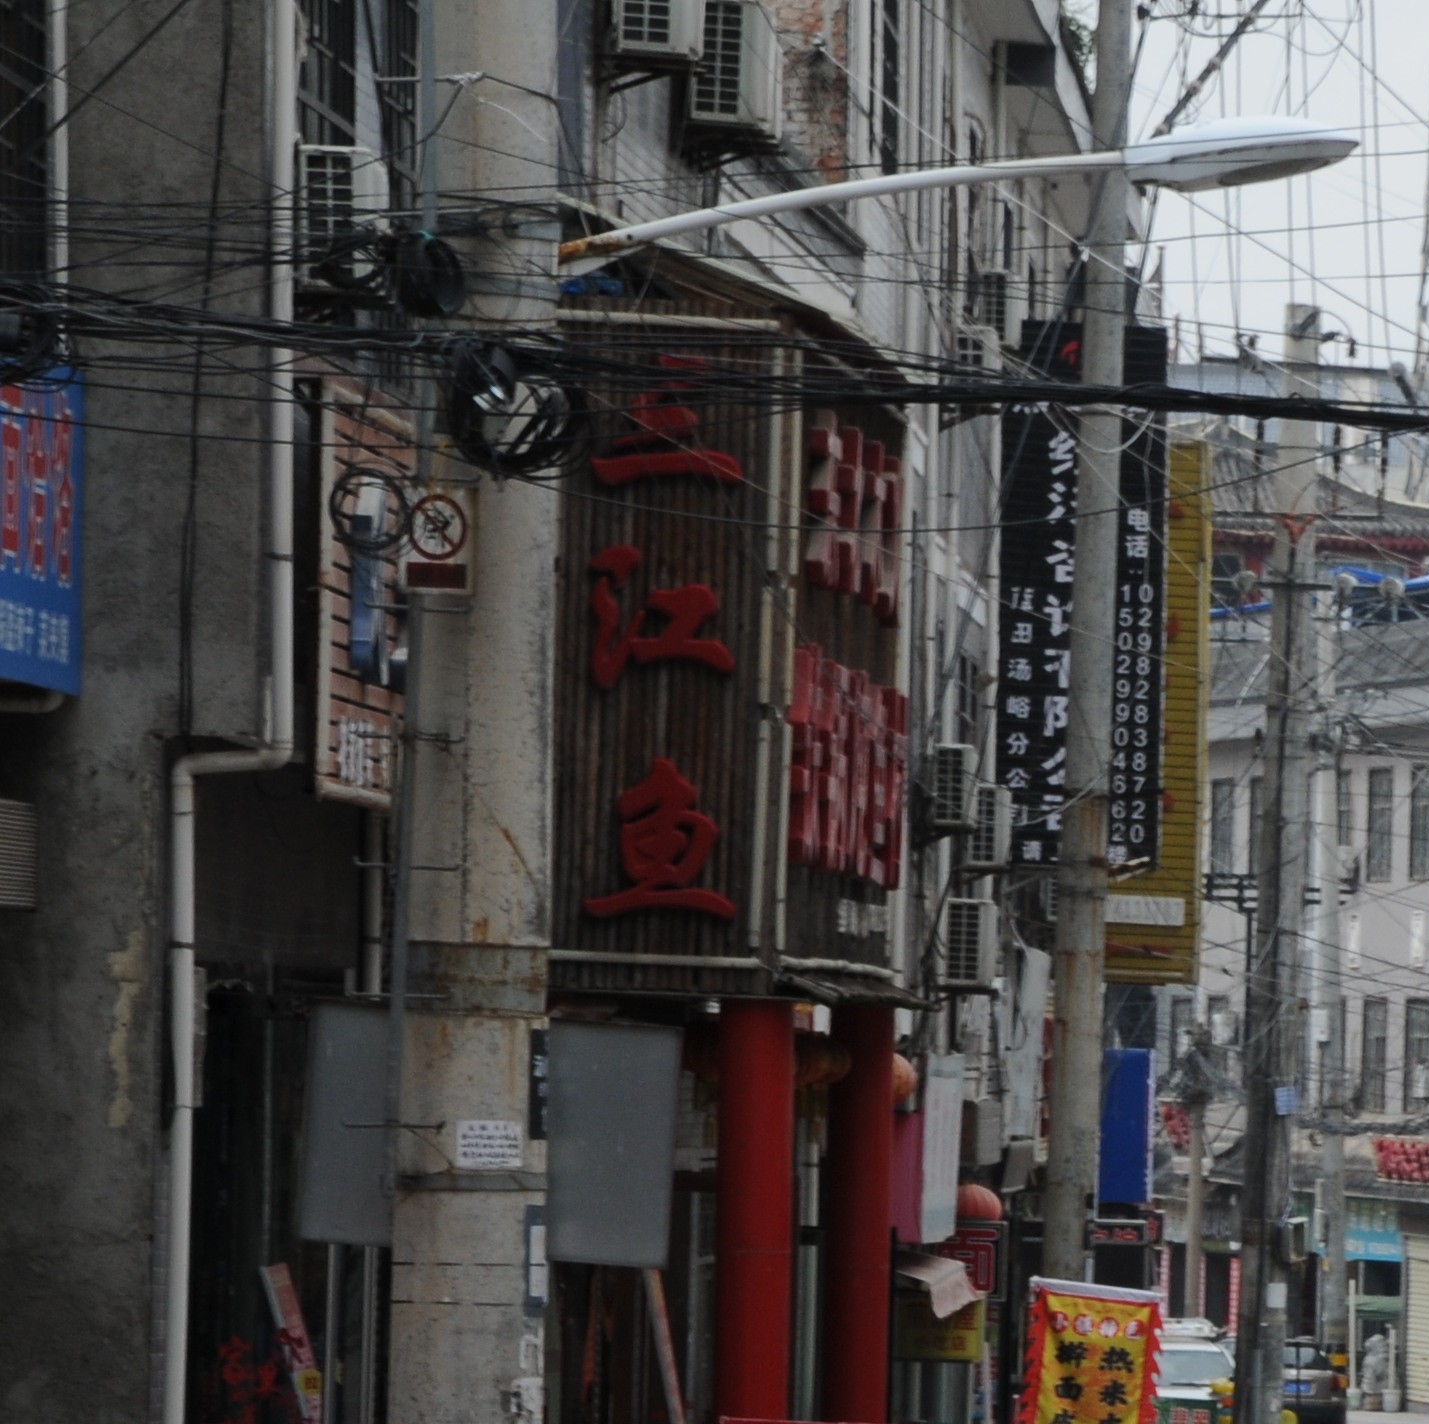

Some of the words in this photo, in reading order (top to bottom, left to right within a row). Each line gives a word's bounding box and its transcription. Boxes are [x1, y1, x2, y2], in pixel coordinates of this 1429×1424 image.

[584, 354, 744, 919] 三江鱼
[1129, 584, 1154, 844] 02982838720
